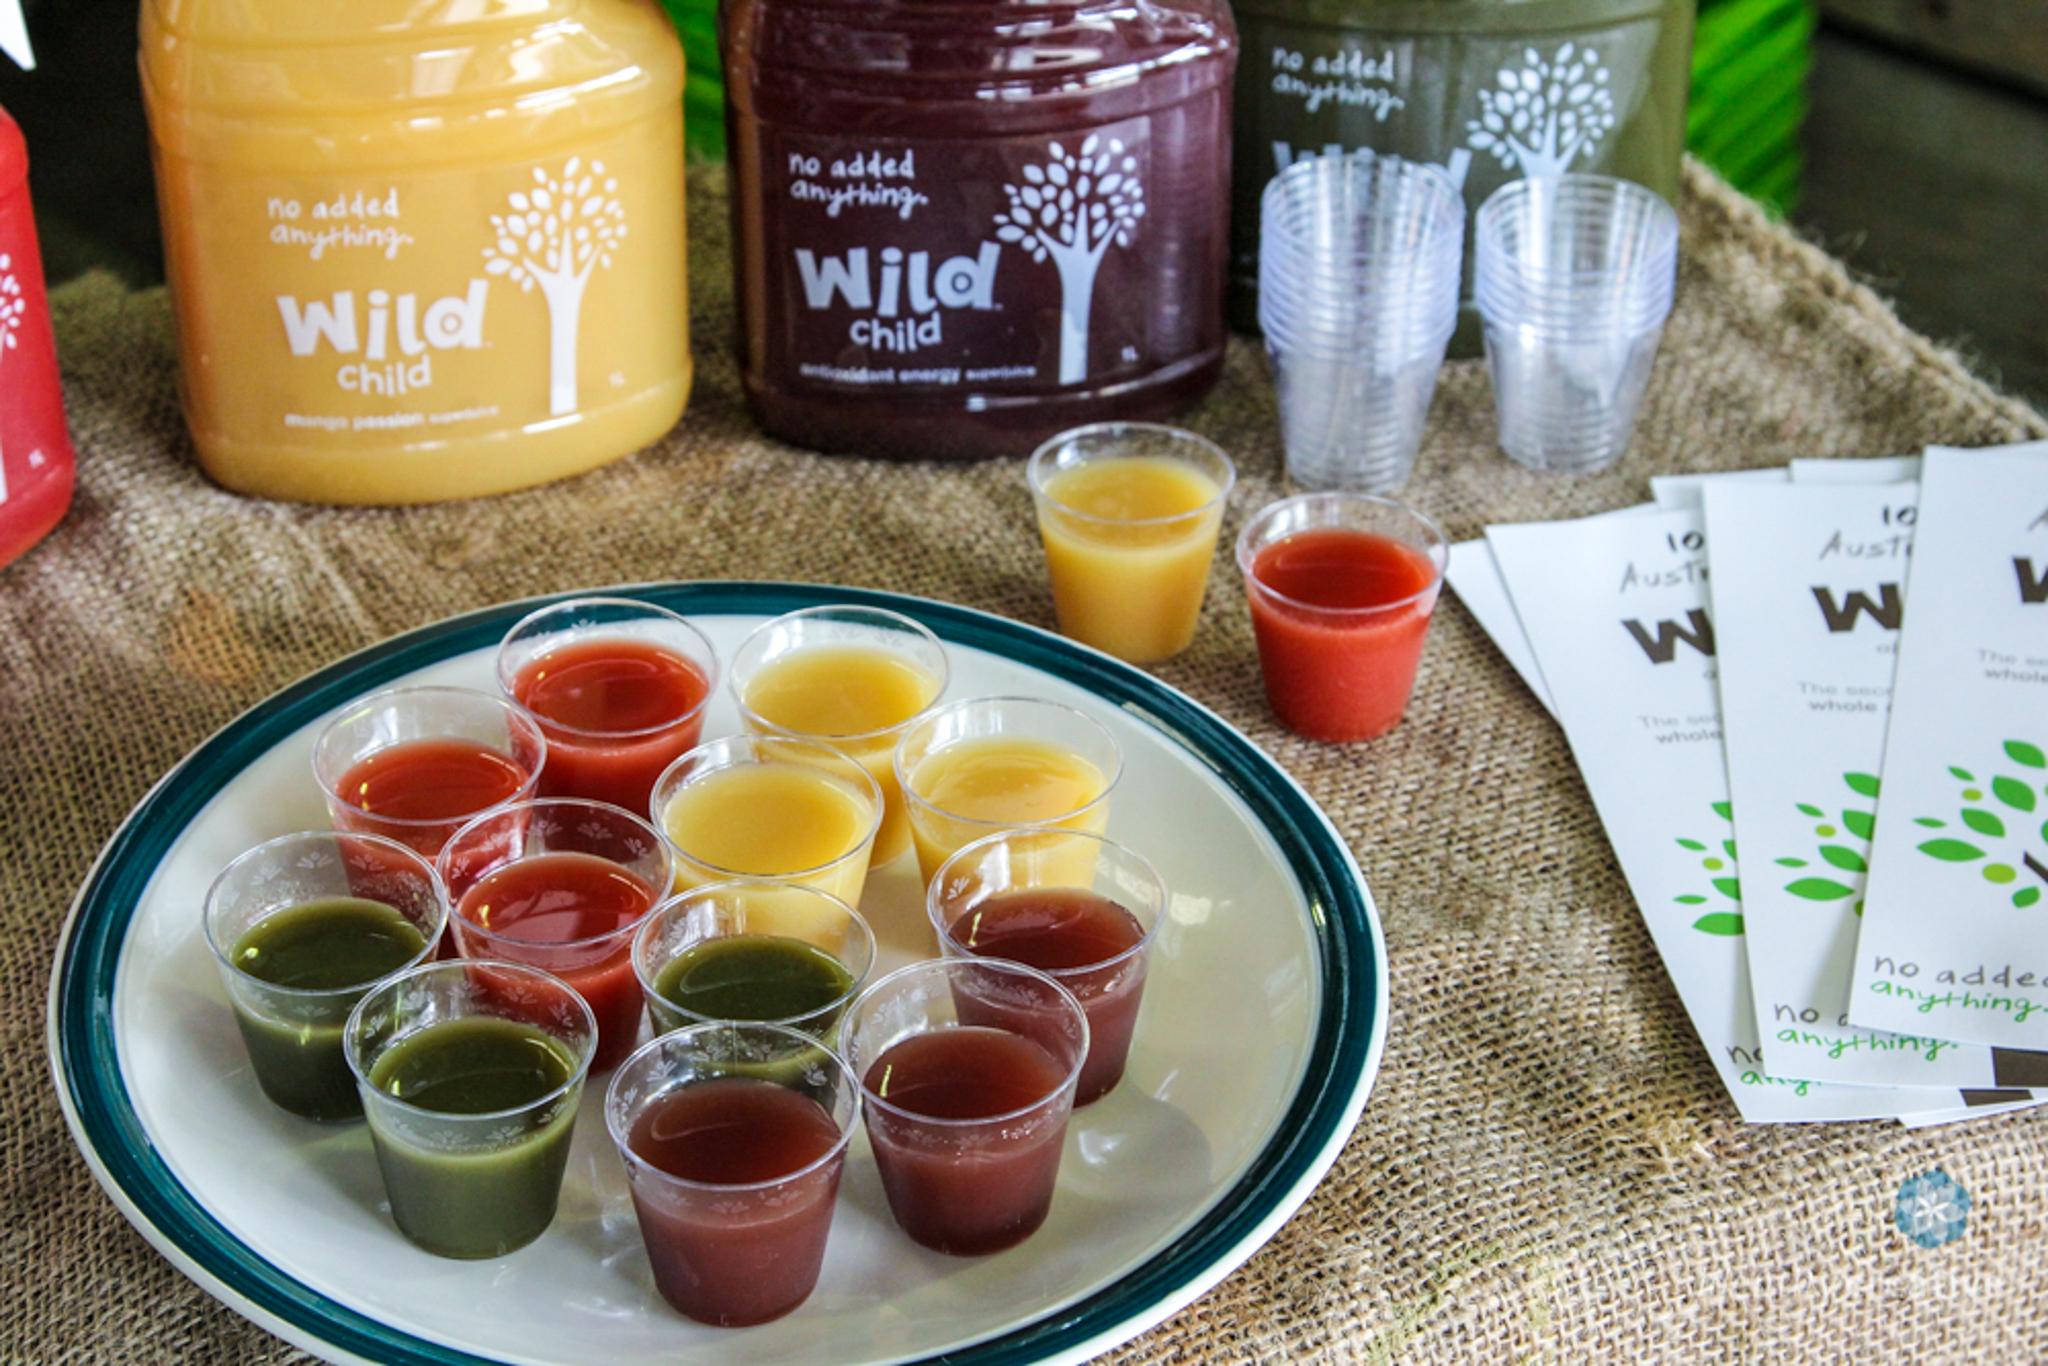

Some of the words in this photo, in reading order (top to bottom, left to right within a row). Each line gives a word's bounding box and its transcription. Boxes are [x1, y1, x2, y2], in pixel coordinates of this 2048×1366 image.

[1272, 48, 1304, 72] no
[1312, 50, 1395, 82] added
[789, 153, 821, 176] no
[830, 148, 915, 180] added
[268, 196, 301, 219] no
[312, 187, 400, 219] added
[789, 179, 929, 220] anything.
[270, 223, 414, 261] anything.
[850, 311, 942, 353] child
[336, 354, 432, 395] child
[899, 367, 960, 385] energy
[1873, 955, 1919, 978] no
[1773, 1003, 1820, 1023] no
[1777, 1028, 1958, 1062] anything.
